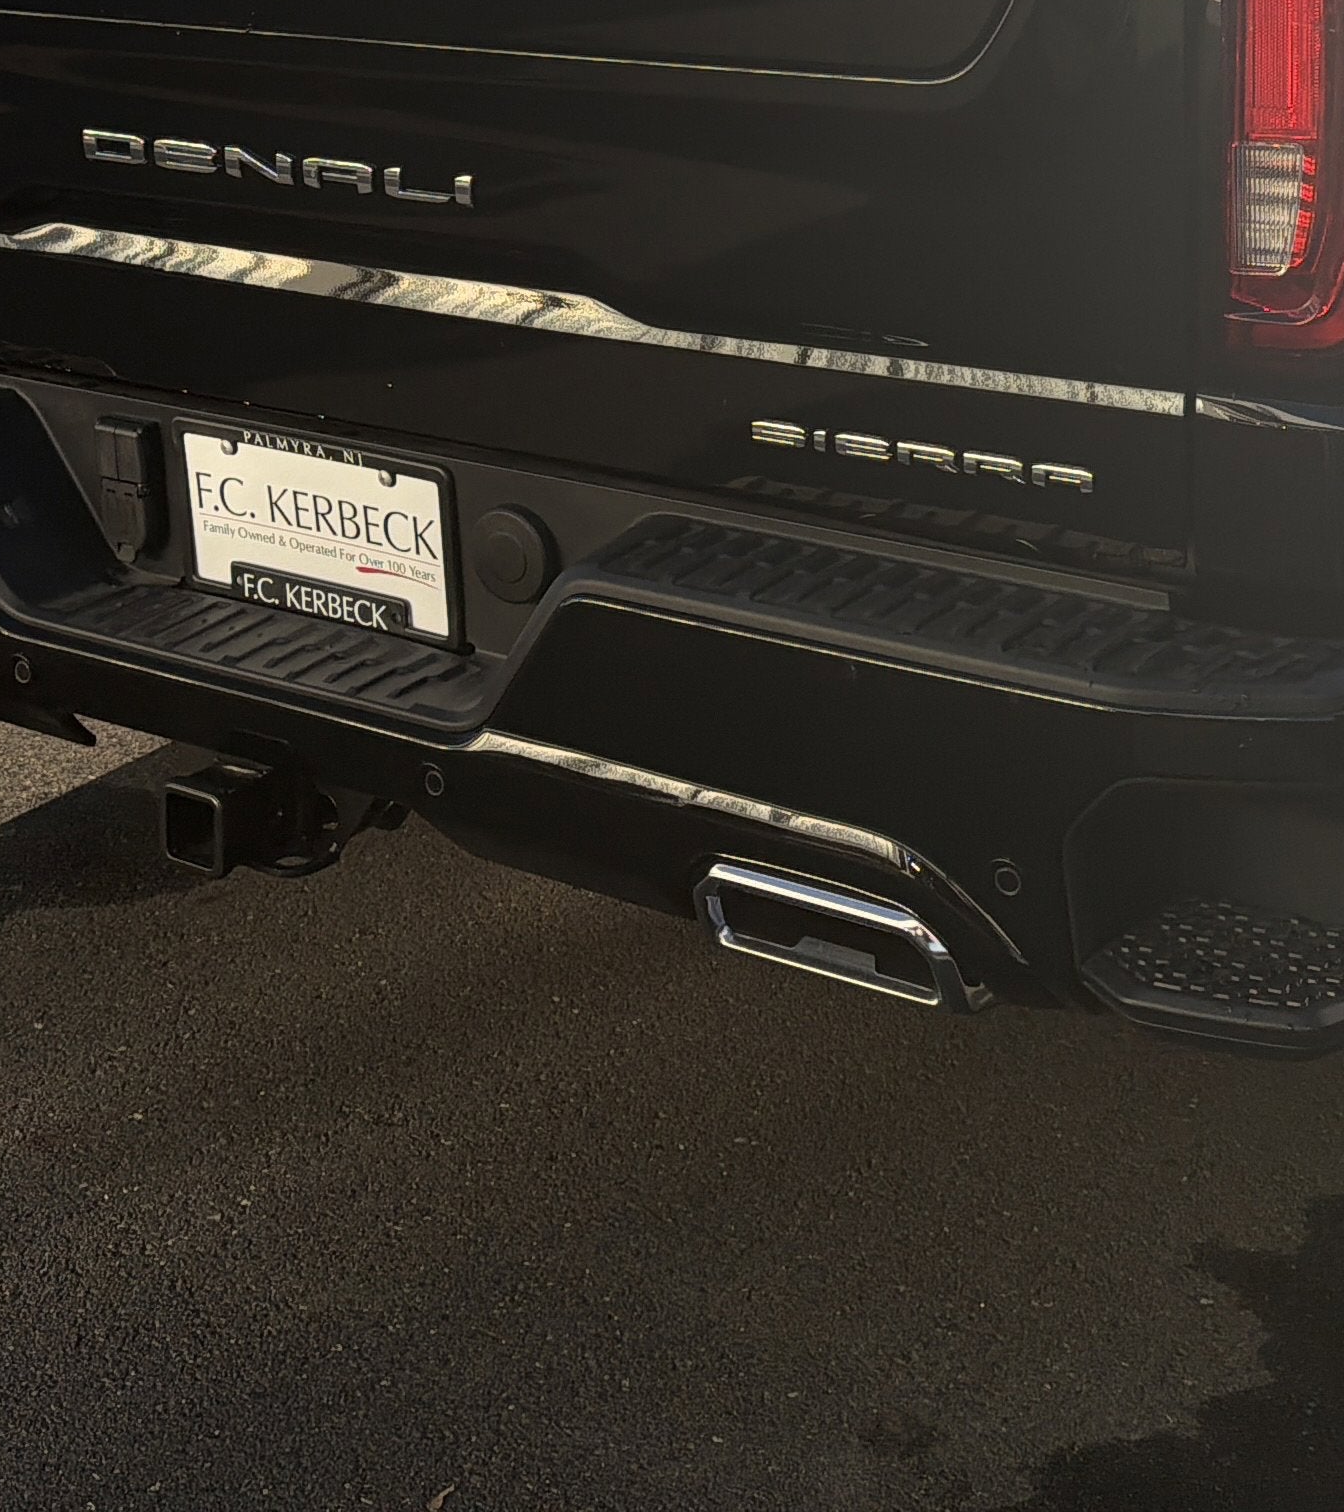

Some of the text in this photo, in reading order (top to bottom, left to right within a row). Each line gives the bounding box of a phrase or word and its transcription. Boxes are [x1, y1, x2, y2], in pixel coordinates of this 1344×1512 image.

[82, 128, 474, 208] DENALI
[242, 430, 364, 467] PALMYRA, NJ
[751, 419, 1094, 494] SIERRA
[194, 471, 439, 561] F.C. KERBECK
[202, 520, 437, 583] Family Owned & Operated For Over 100 Years
[242, 572, 389, 631] F.C. KERBECK
